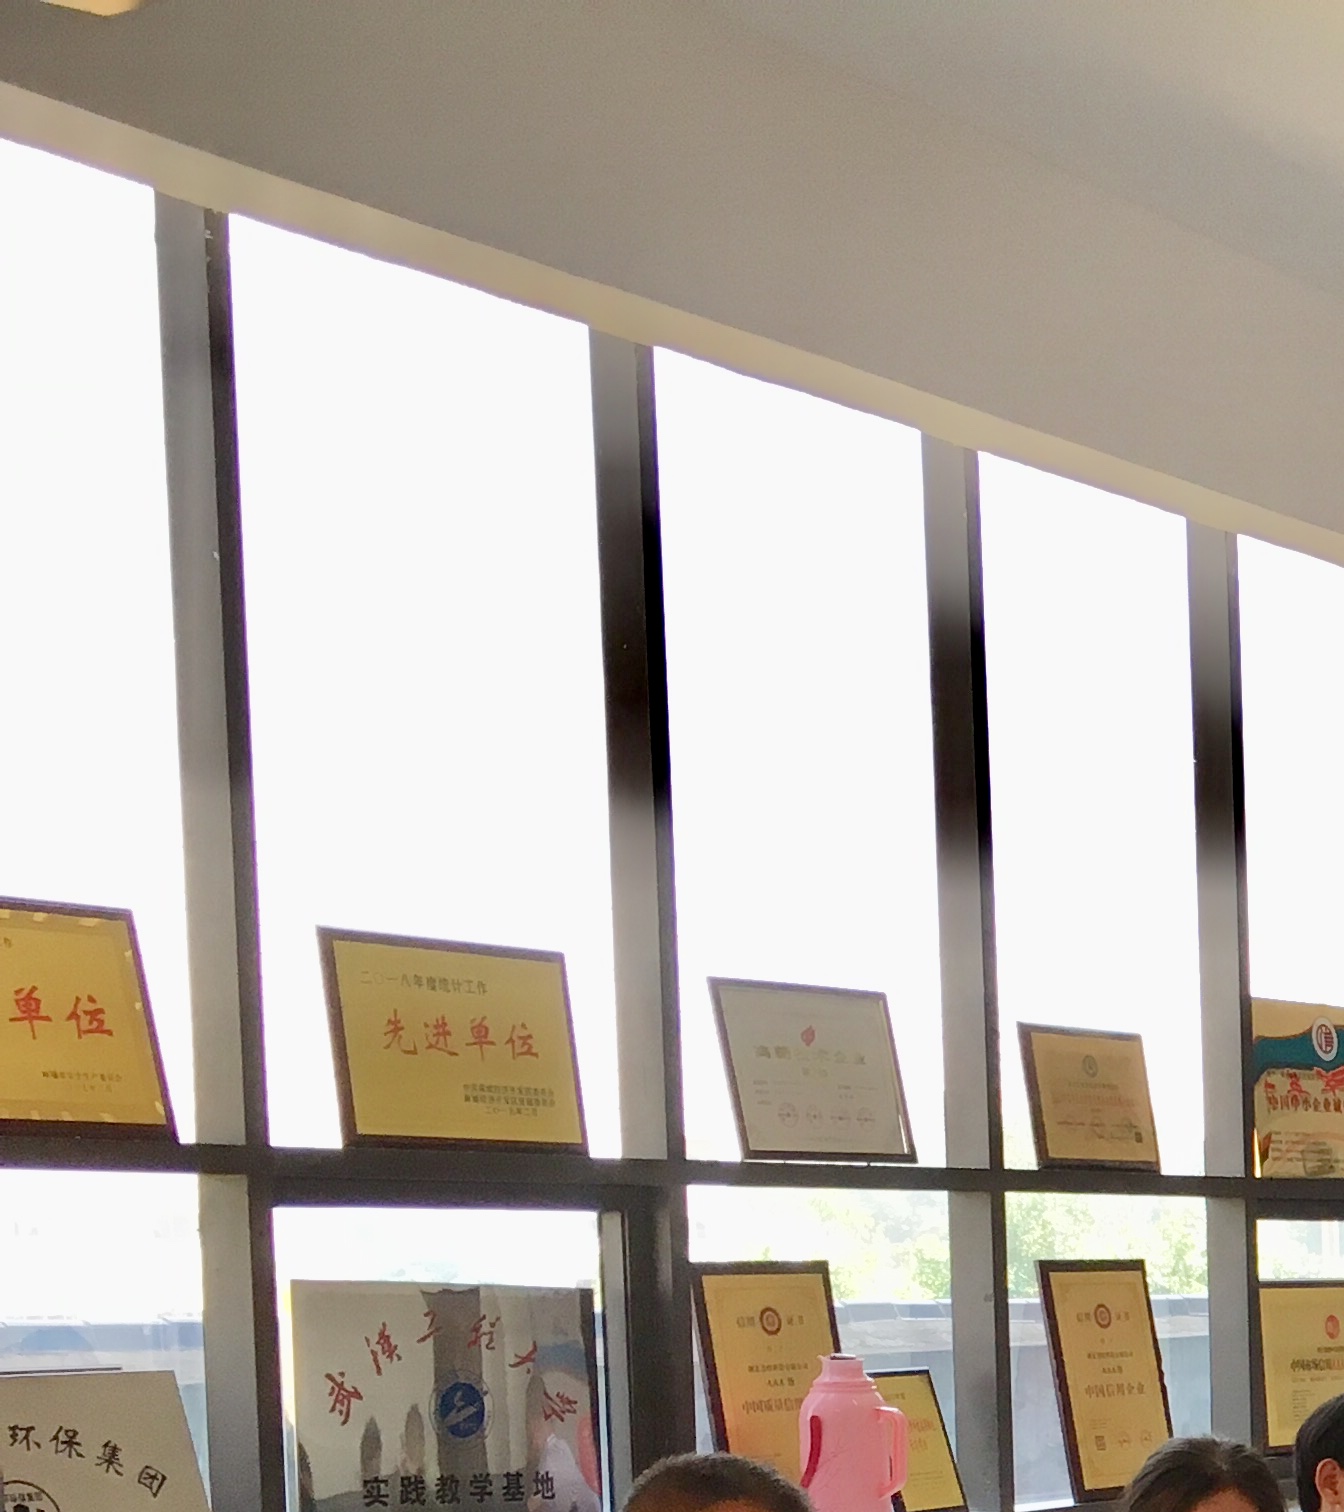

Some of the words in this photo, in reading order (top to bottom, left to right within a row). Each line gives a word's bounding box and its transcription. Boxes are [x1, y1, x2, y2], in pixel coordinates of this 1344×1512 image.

[8, 984, 114, 1041] 单位
[382, 1008, 540, 1062] 先进单位
[8, 1423, 168, 1499] 环保集团
[362, 1471, 556, 1507] 实践教学基地
